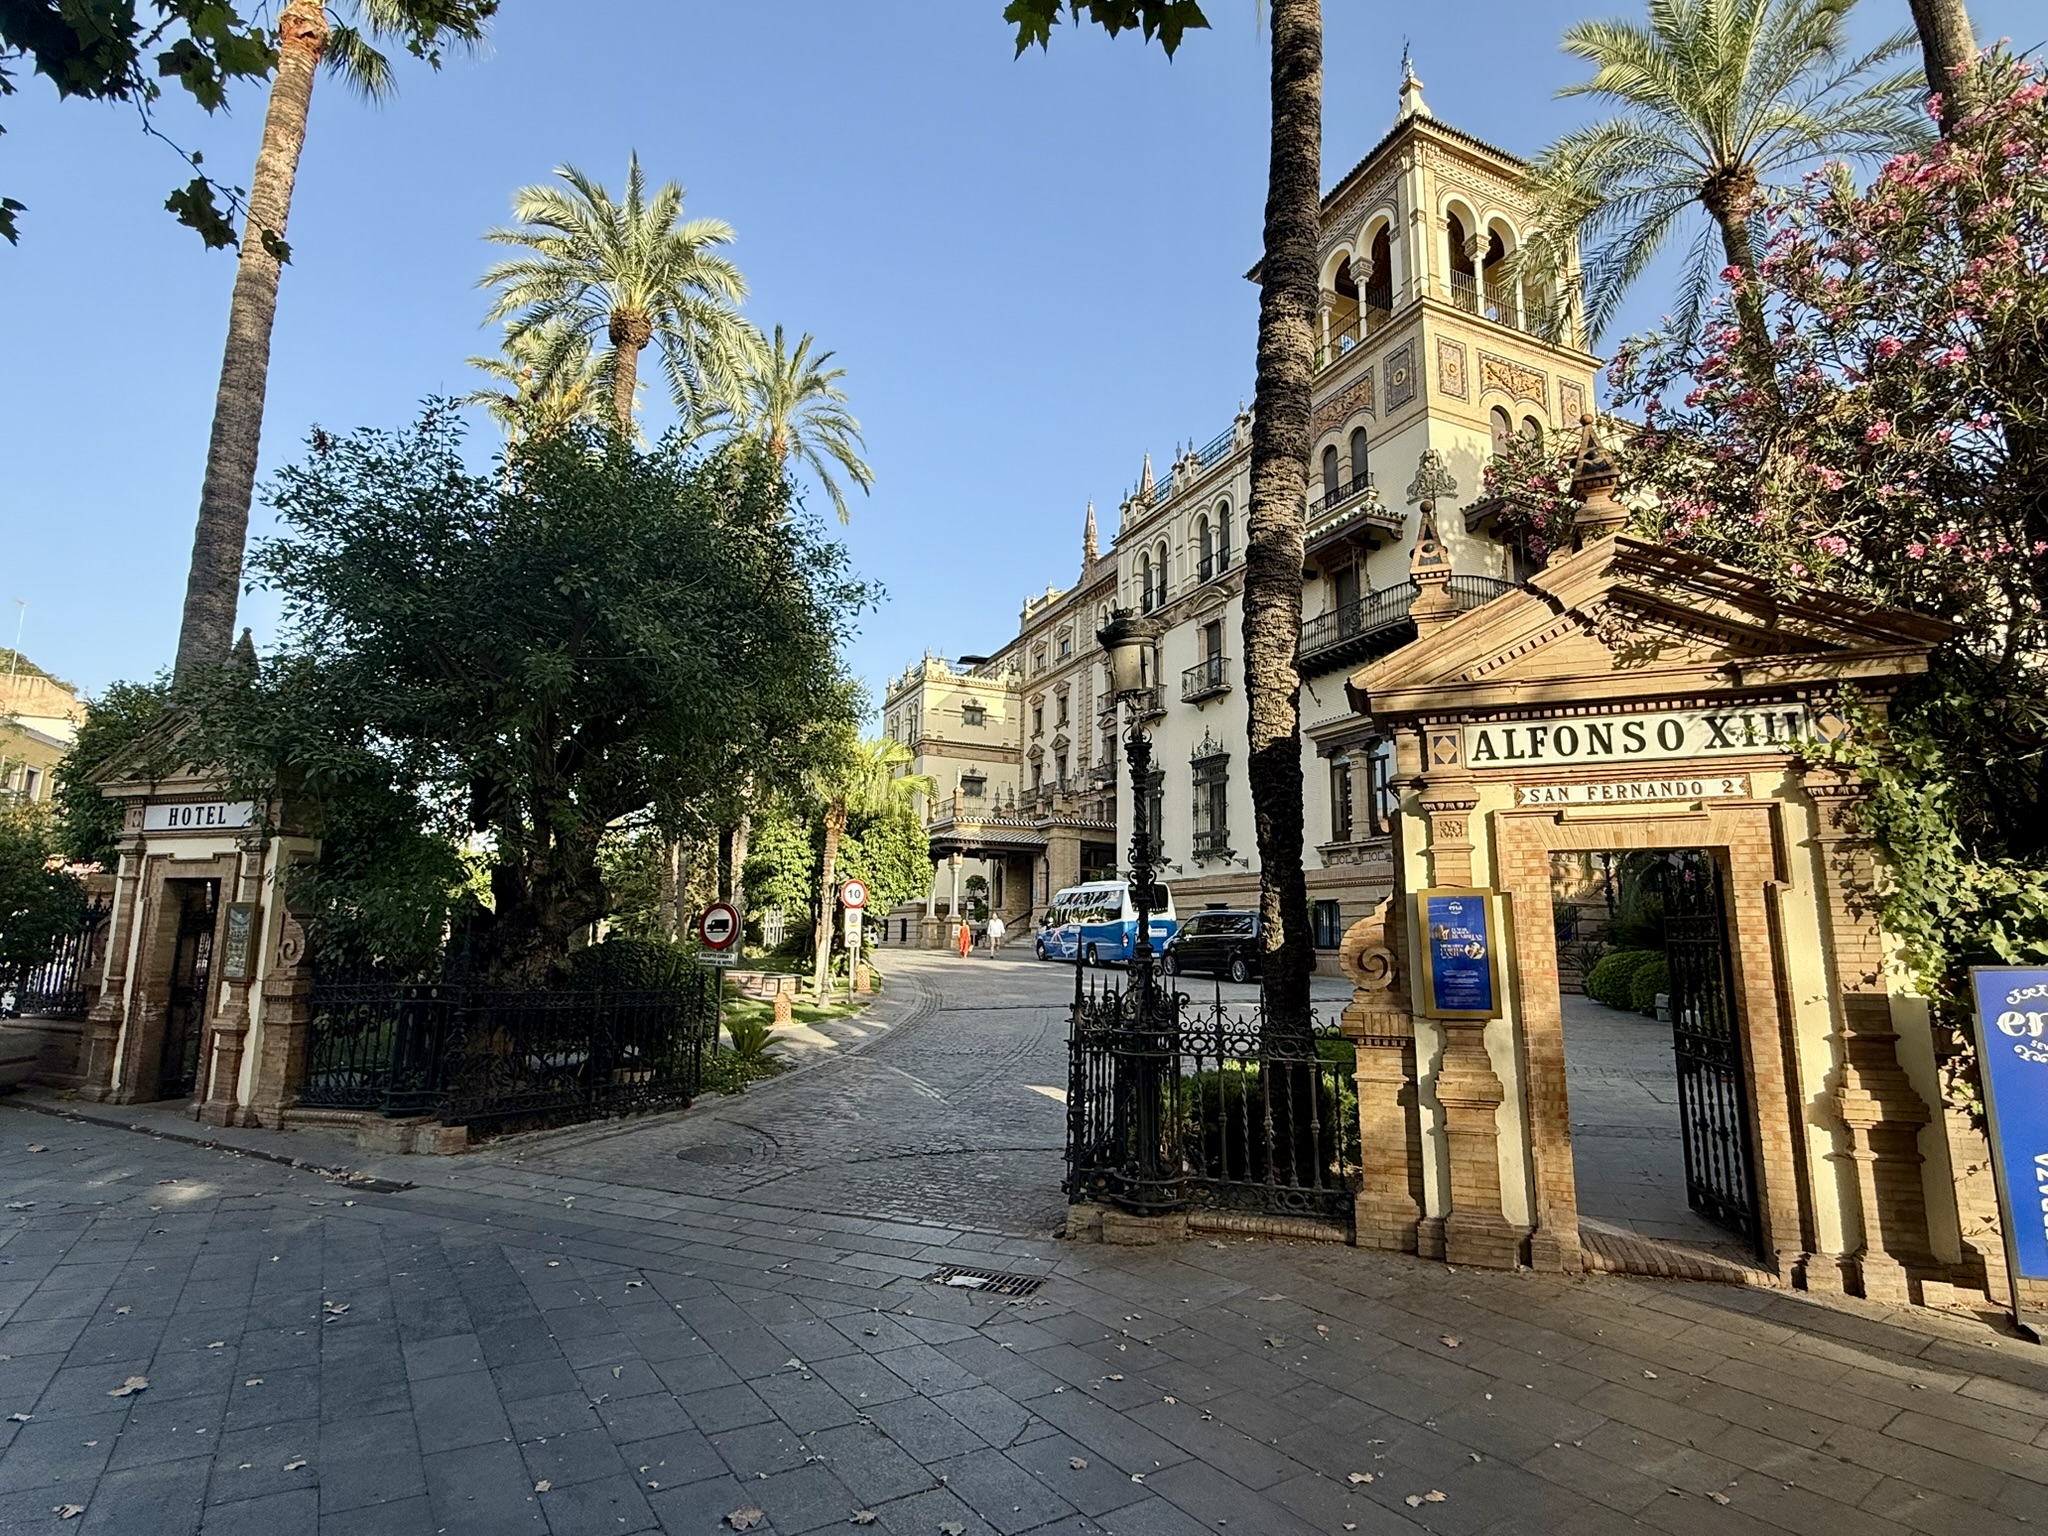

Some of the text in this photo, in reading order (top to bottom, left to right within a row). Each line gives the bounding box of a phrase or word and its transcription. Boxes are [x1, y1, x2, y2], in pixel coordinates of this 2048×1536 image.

[1471, 711, 1799, 761] ALFONSO XIII
[1530, 779, 1735, 803] SAN FERNANDO 2
[168, 806, 226, 826] HOTEL
[848, 889, 861, 899] 10
